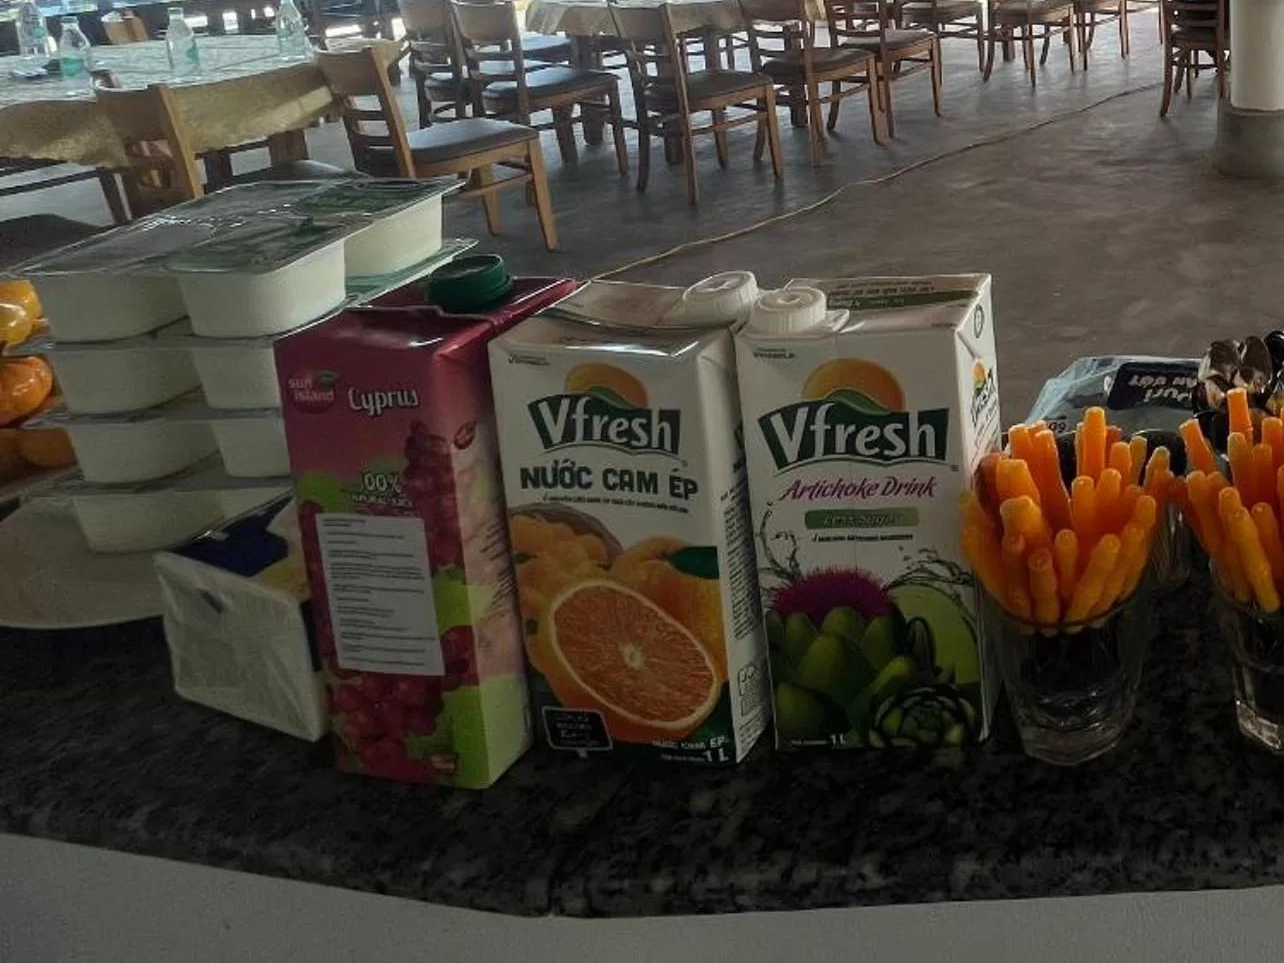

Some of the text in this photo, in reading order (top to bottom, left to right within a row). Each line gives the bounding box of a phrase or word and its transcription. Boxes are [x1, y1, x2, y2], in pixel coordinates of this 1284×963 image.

[348, 386, 419, 416] Cyprus
[536, 396, 672, 451] Vfresh
[769, 403, 937, 464] Vfresh
[520, 459, 698, 500] NƯỚC CAM ÉP
[778, 476, 937, 501] Artichoke Drink
